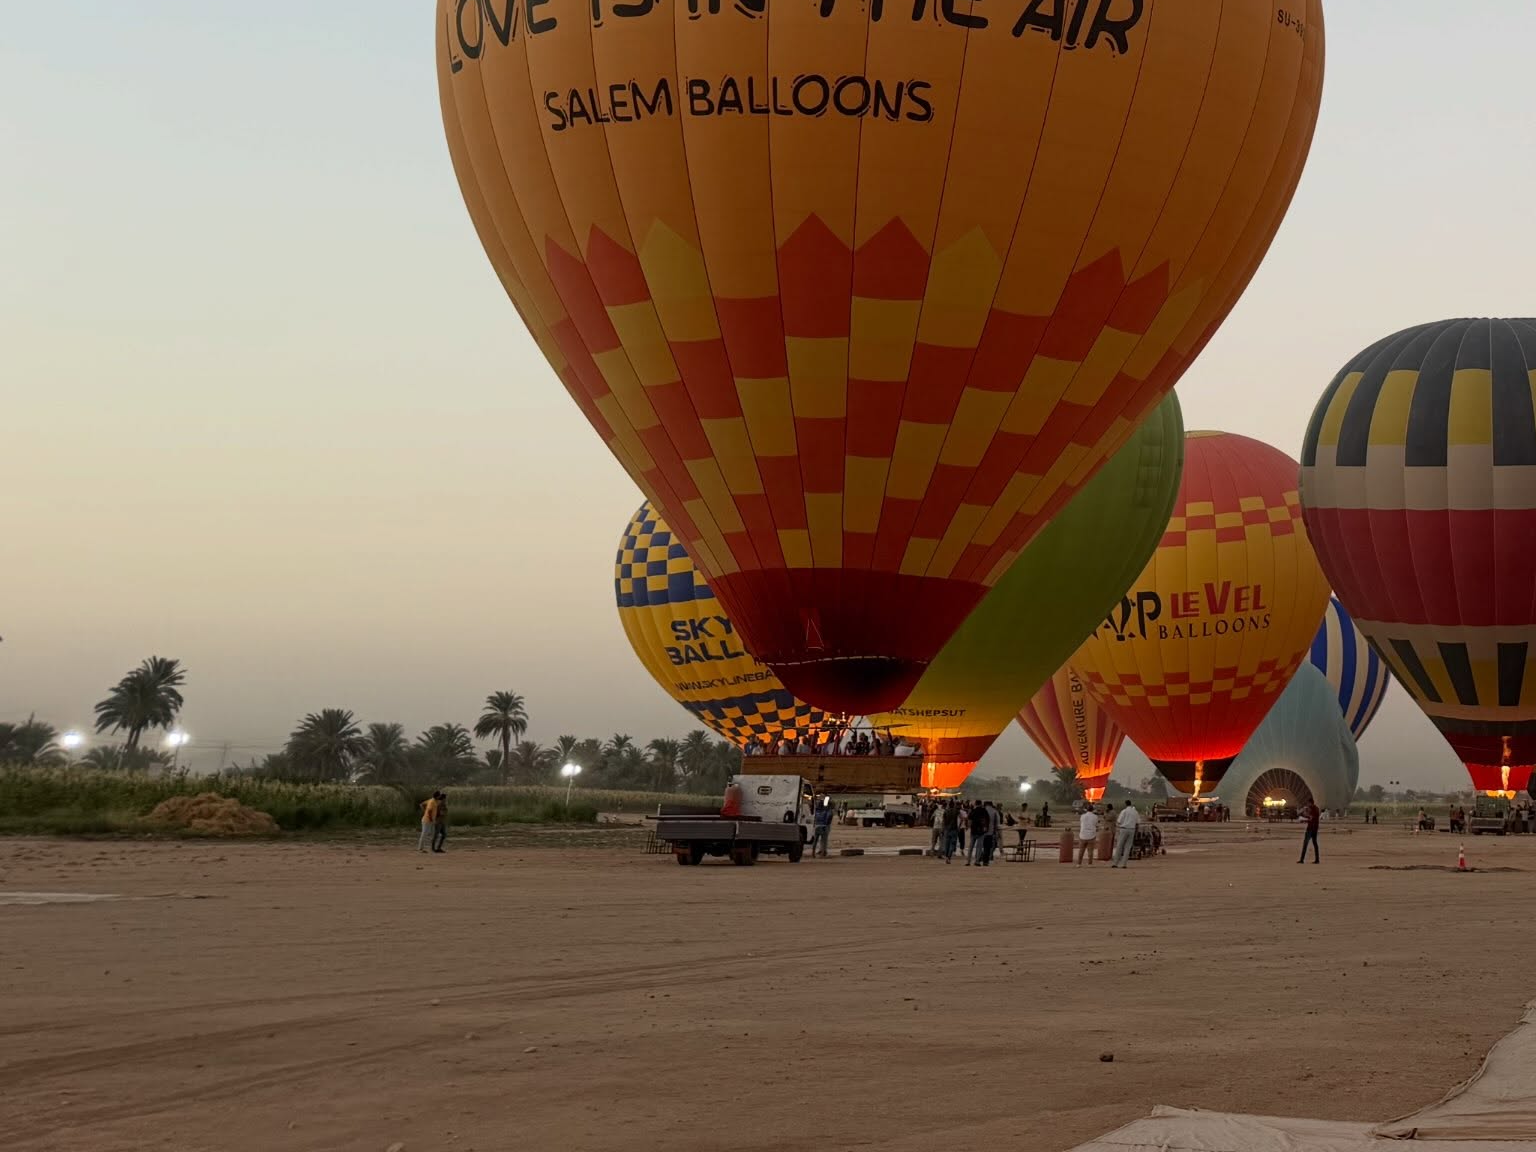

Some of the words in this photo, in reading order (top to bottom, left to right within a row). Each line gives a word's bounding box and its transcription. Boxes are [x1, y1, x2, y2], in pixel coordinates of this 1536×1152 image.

[545, 77, 673, 132] SALEM
[686, 74, 935, 123] BALLOONS
[1170, 580, 1267, 620] LEVEL
[1159, 613, 1271, 640] BALLOONS
[1070, 669, 1084, 693] BA
[1072, 699, 1090, 766] ADVENTURE
